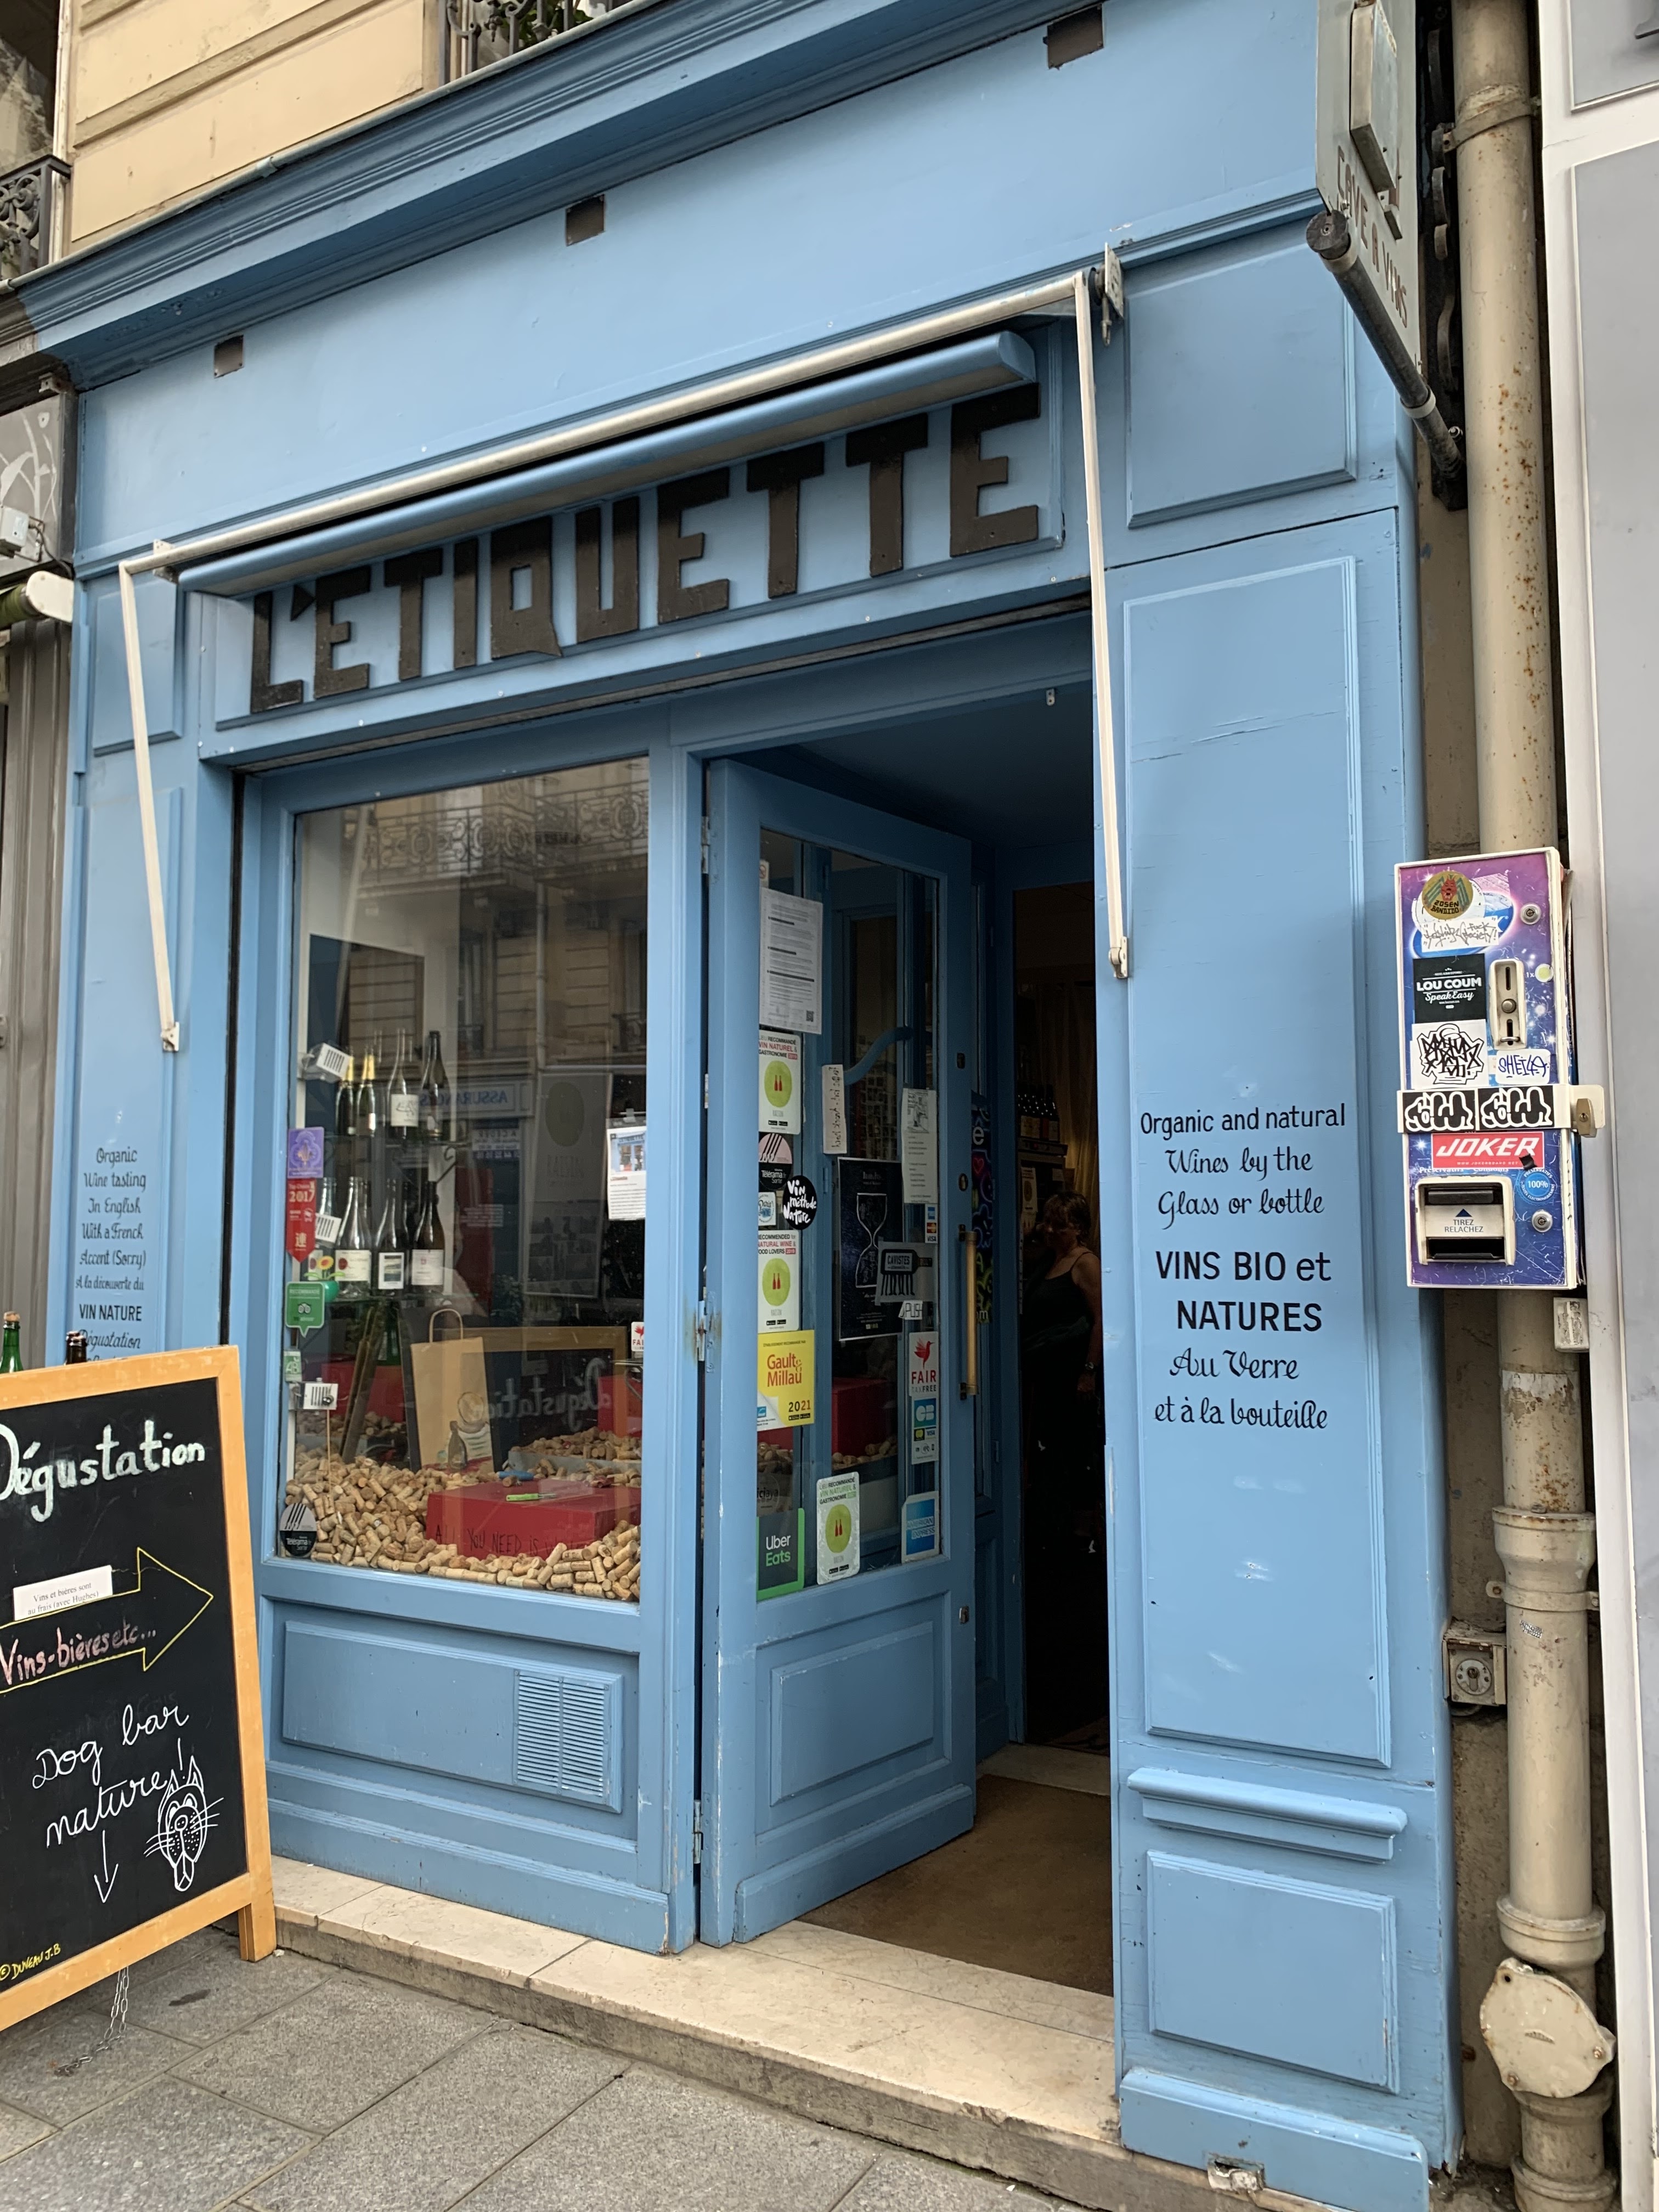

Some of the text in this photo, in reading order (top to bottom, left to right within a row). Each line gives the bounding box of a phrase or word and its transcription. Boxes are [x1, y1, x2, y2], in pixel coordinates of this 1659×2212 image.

[1382, 240, 1407, 329] VINS
[250, 382, 1041, 714] L'ETIQUETTE
[1417, 977, 1482, 991] LOU COUM
[769, 1043, 793, 1052] NATUREL
[1141, 1103, 1346, 1141] Organic and natural
[1436, 1137, 1539, 1156] JOKER
[96, 1146, 138, 1169] Organic
[1165, 1146, 1313, 1181] Wines by the
[111, 1172, 146, 1193] tasting
[1528, 1180, 1548, 1188] 100%
[289, 1189, 315, 1203] 2017
[104, 1197, 142, 1219] English
[1158, 1188, 1325, 1230] Glass or bottle
[104, 1228, 110, 1239] a
[1155, 1250, 1332, 1282] VINS BIO et
[79, 1303, 142, 1322] VIN NATURE
[1177, 1300, 1323, 1333] NATURES
[767, 1352, 796, 1370] Gault
[1169, 1347, 1299, 1380] Au Verre
[767, 1370, 802, 1387] Millau
[911, 1369, 936, 1384] FAIR
[788, 1400, 811, 1413] 2021
[1155, 1395, 1328, 1430] et à la bouteille
[493, 1531, 522, 1554] NEED
[766, 1534, 791, 1550] Uber
[766, 1550, 791, 1567] Eats
[33, 1582, 92, 1603] Vins et bières sont
[37, 1602, 52, 1613] frais
[53, 1597, 71, 1609] (avec
[32, 1704, 189, 1789] Dog bar
